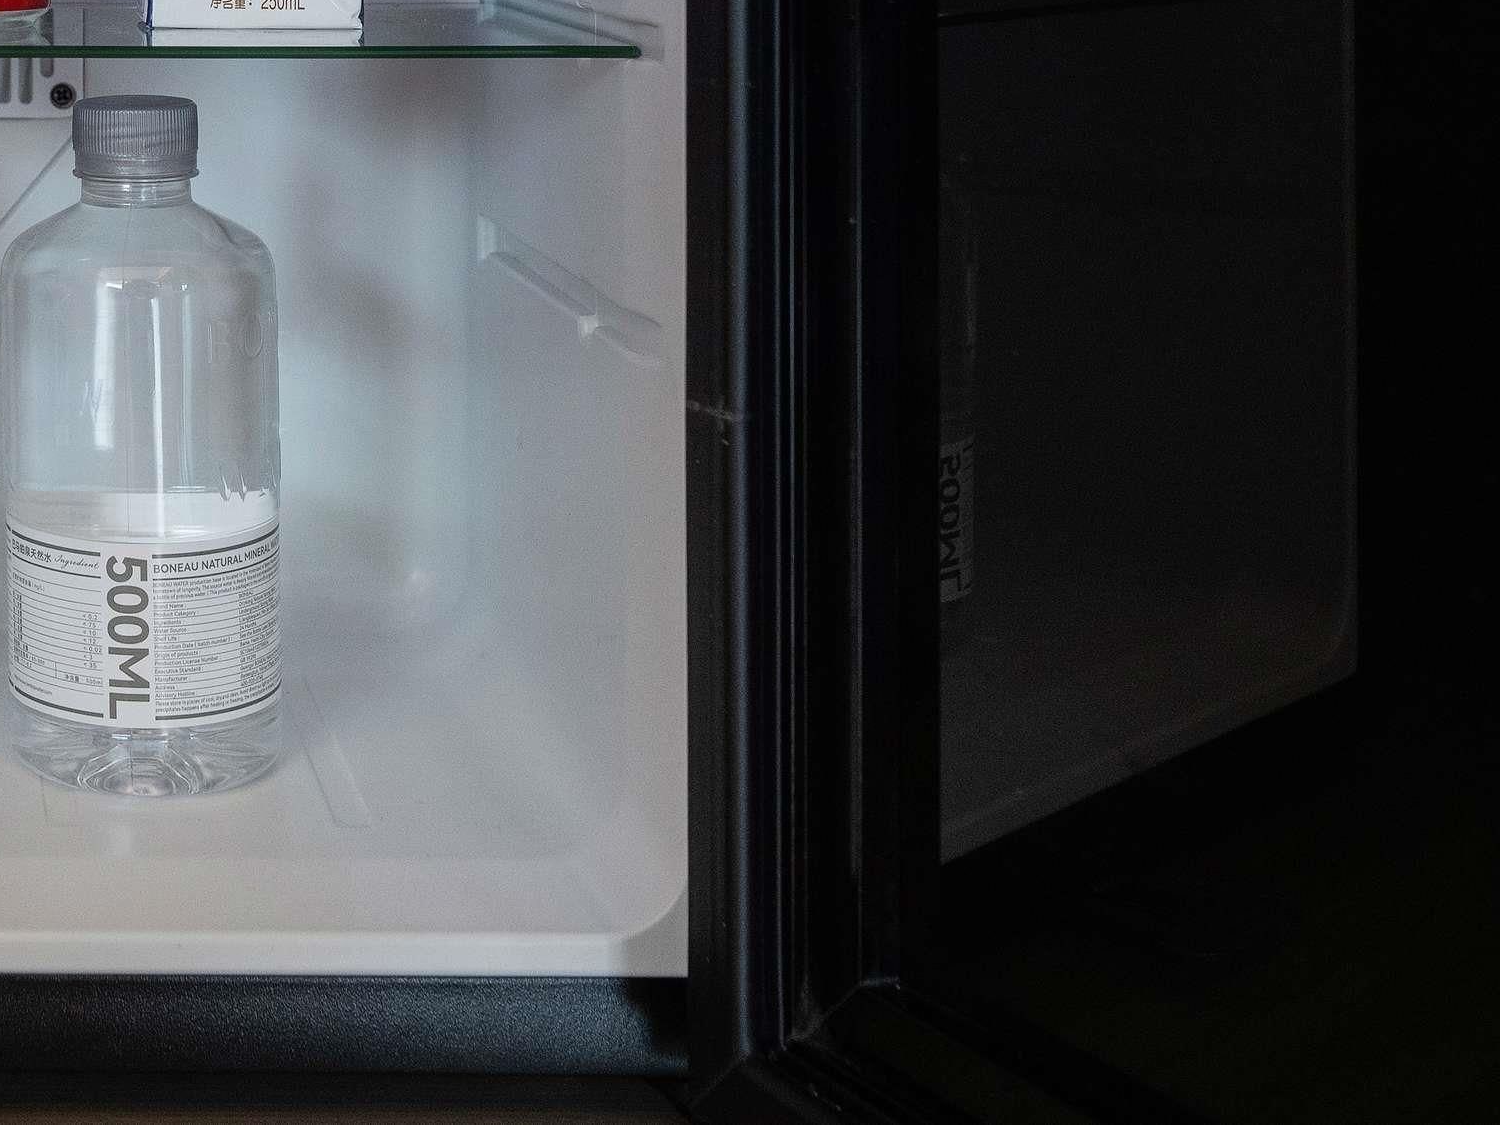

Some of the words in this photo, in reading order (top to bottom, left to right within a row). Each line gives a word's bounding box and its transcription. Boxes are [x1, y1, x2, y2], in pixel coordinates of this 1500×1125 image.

[153, 562, 199, 573] BONEAU
[201, 556, 243, 571] NATURAL
[244, 544, 271, 561] MINERAL
[106, 556, 150, 720] 500ML
